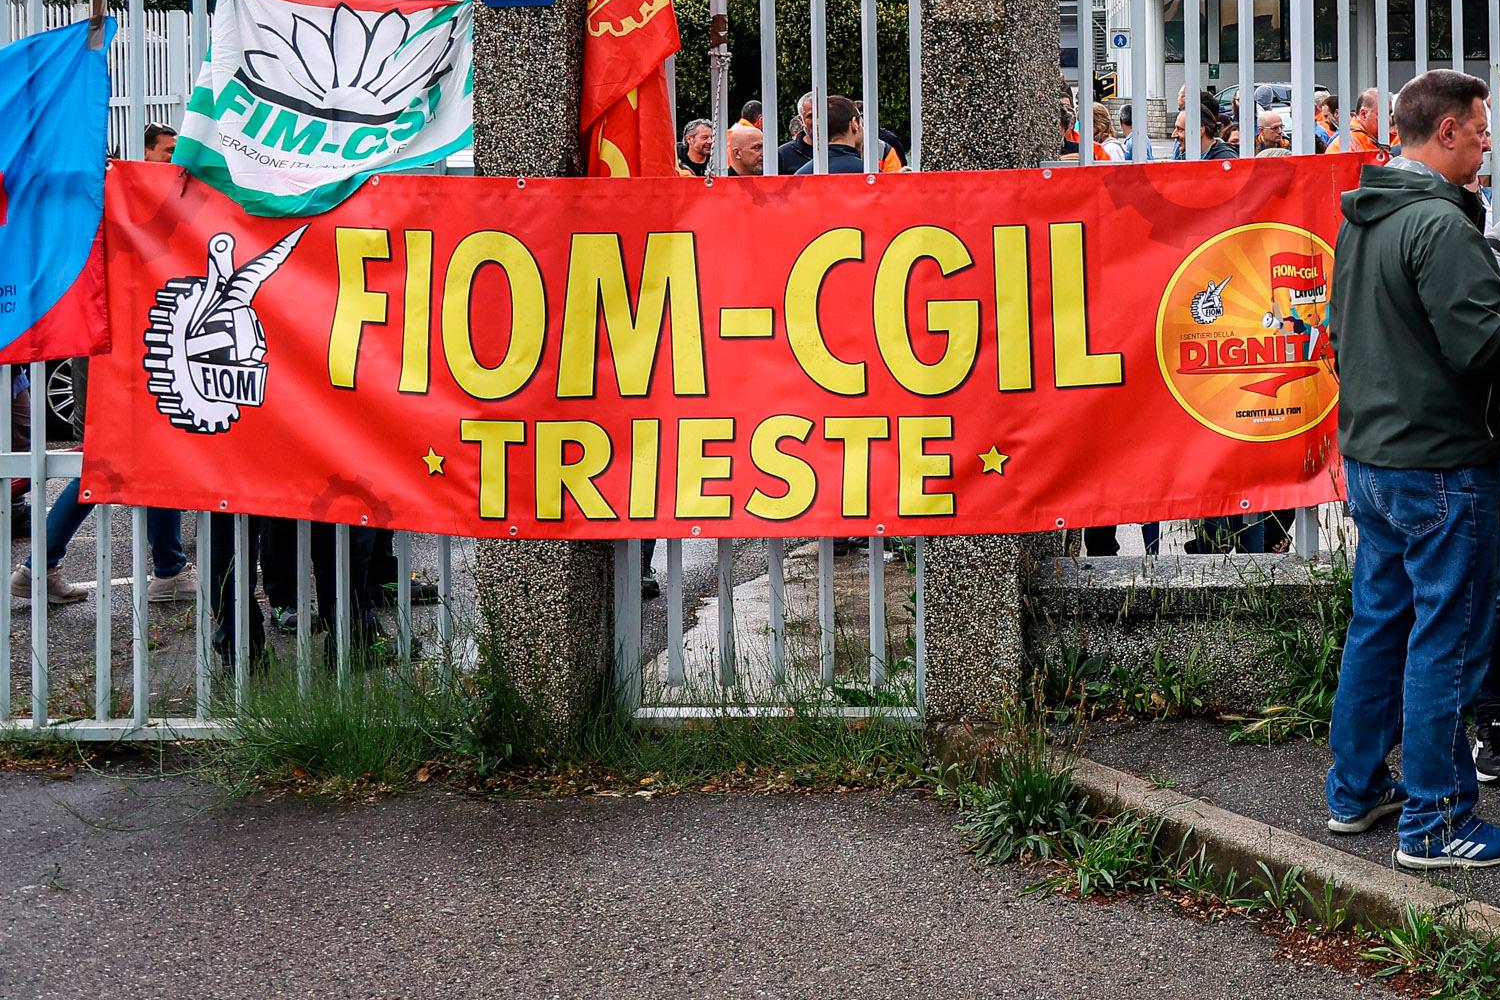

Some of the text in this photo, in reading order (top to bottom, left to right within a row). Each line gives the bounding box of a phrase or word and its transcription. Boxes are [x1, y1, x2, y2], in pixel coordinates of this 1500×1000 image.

[1273, 264, 1319, 279] FIOM-CGIL
[327, 221, 1124, 401] FIOM-CGIL
[1205, 308, 1222, 317] FIOM
[1183, 332, 1213, 341] SENTIERI
[1213, 331, 1235, 339] DELLA
[202, 366, 257, 402] FIOM
[1235, 406, 1302, 418] ISCRIVITI ALLA FIOM
[459, 414, 955, 521] TRIESTE
